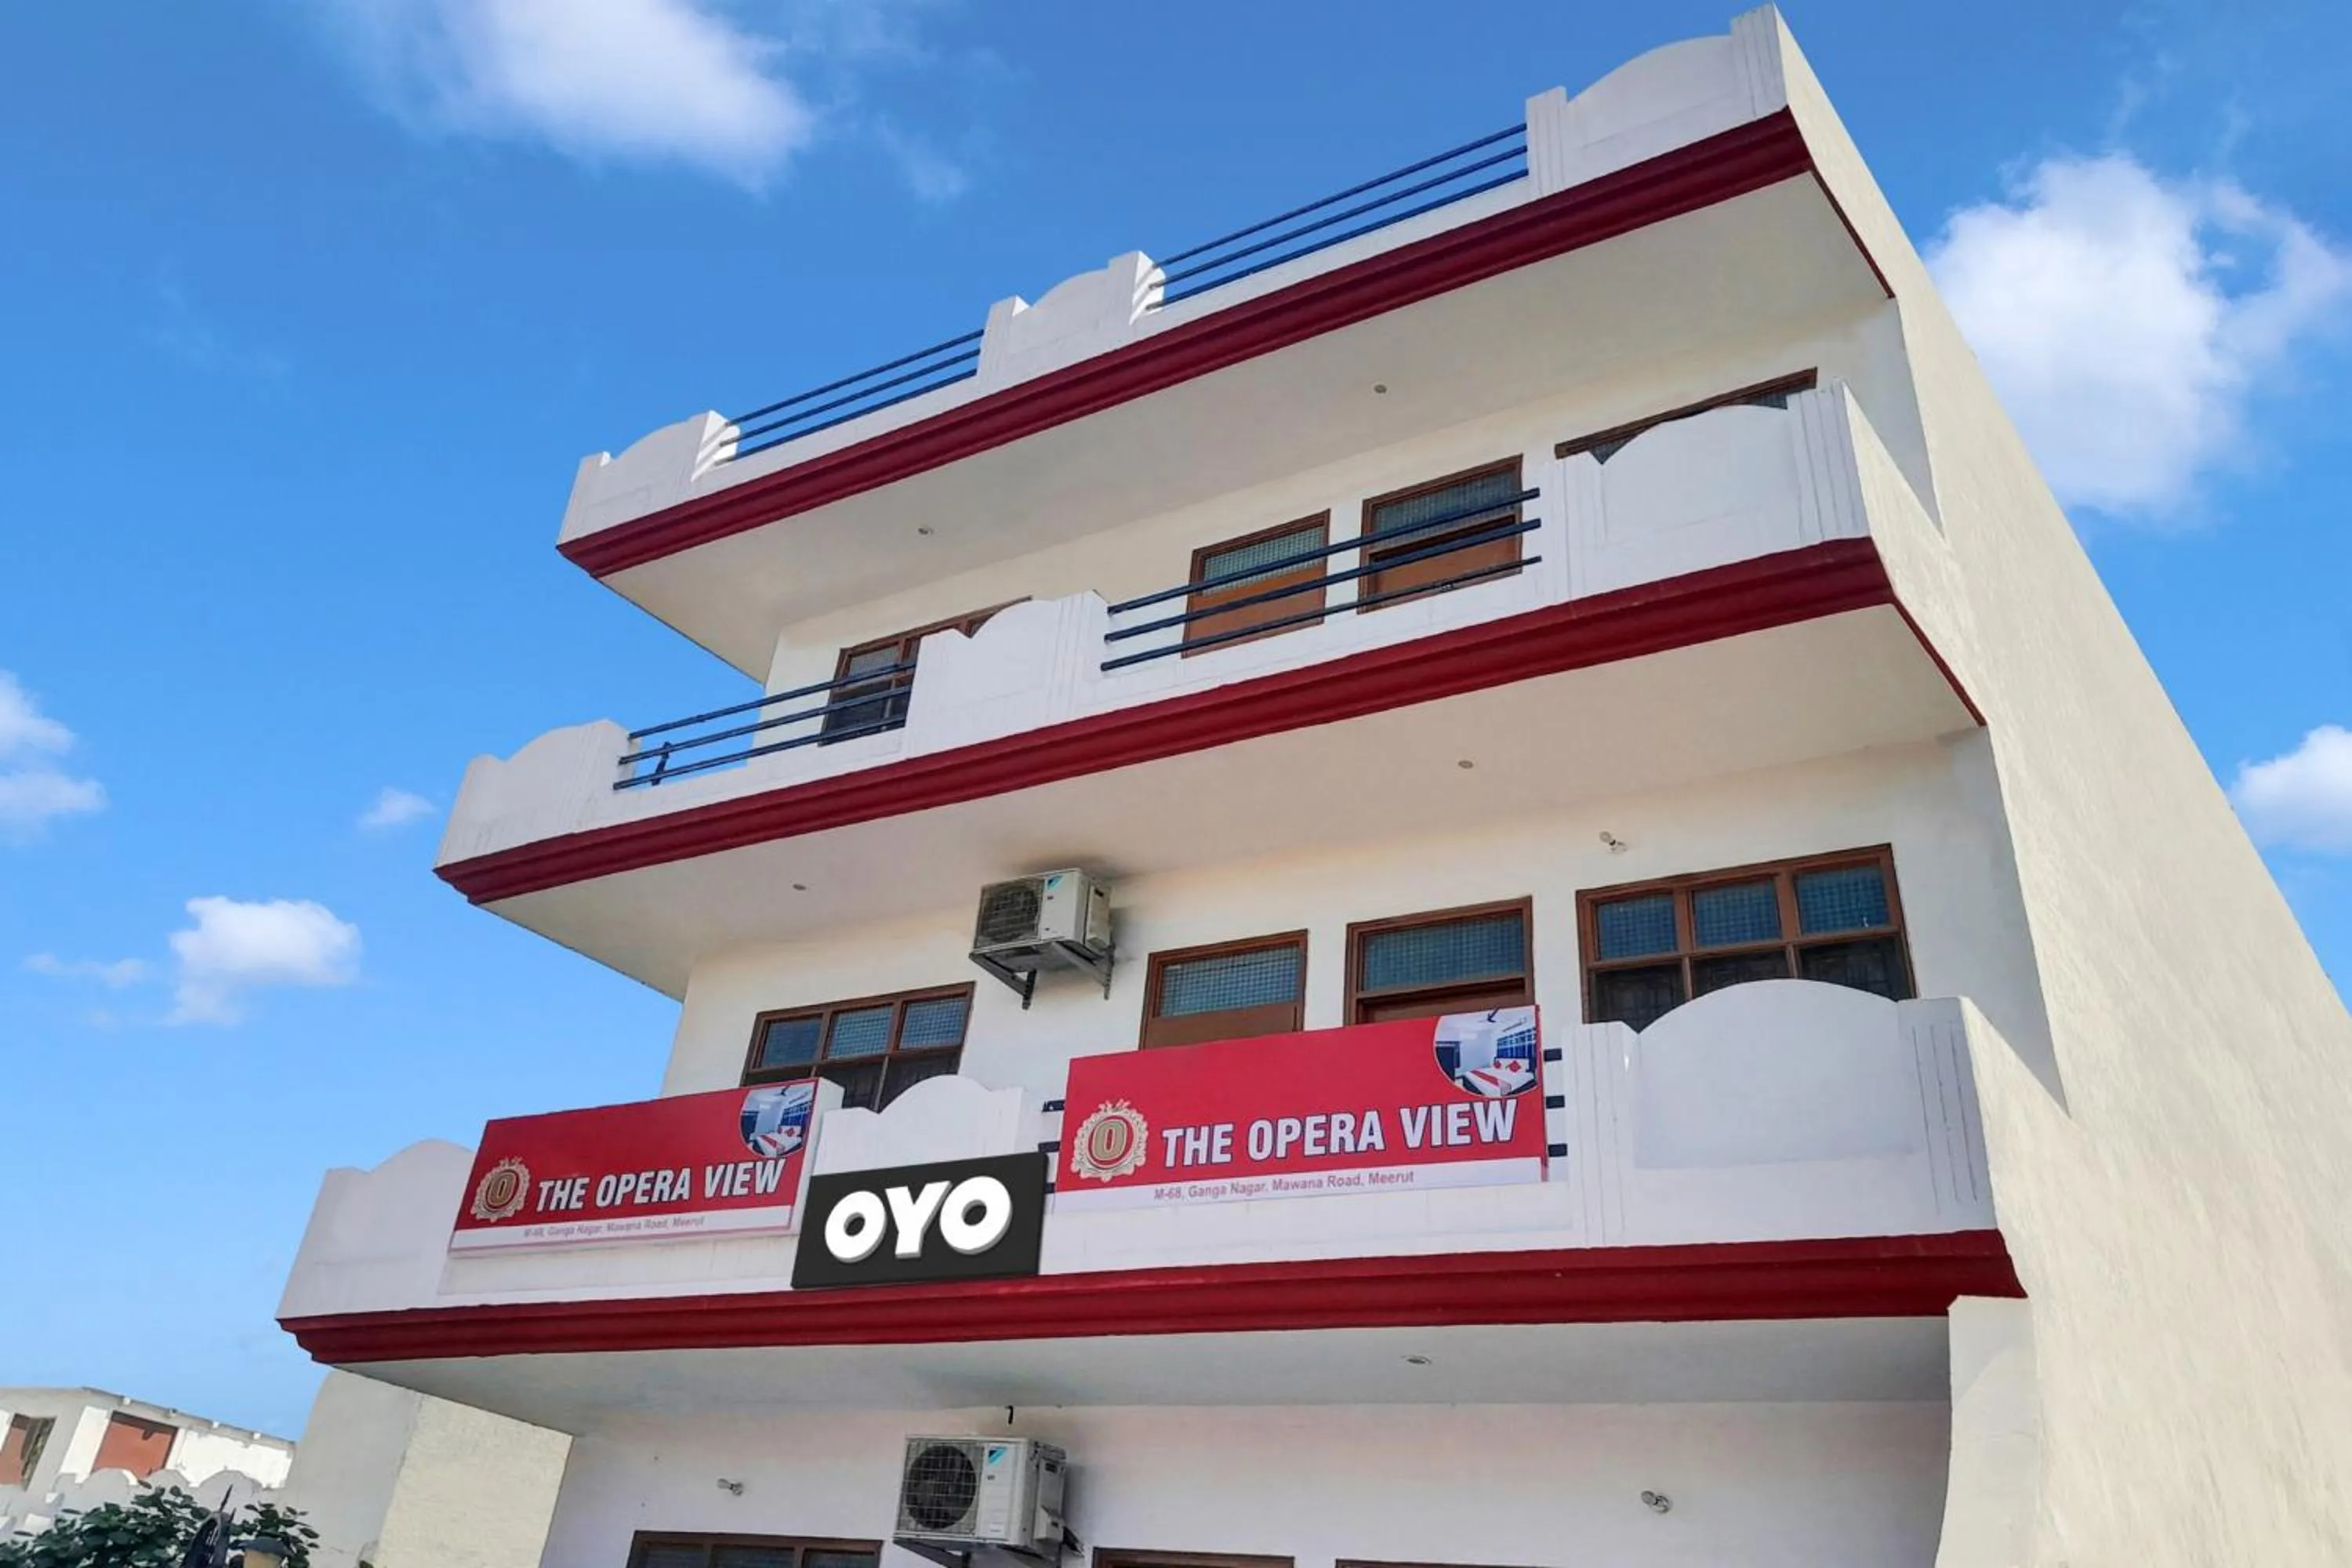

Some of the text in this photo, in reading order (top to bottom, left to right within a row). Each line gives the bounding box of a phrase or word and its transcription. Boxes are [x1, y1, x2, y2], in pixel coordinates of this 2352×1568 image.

[1162, 1098, 1518, 1168] THE OPERA VIEW
[536, 1158, 786, 1213] THE OPERA VIEW
[1189, 1185, 1227, 1198] Ganga
[1272, 1178, 1323, 1191] Mawana
[1368, 1171, 1414, 1185] Meerut
[825, 1175, 1012, 1264] OYO
